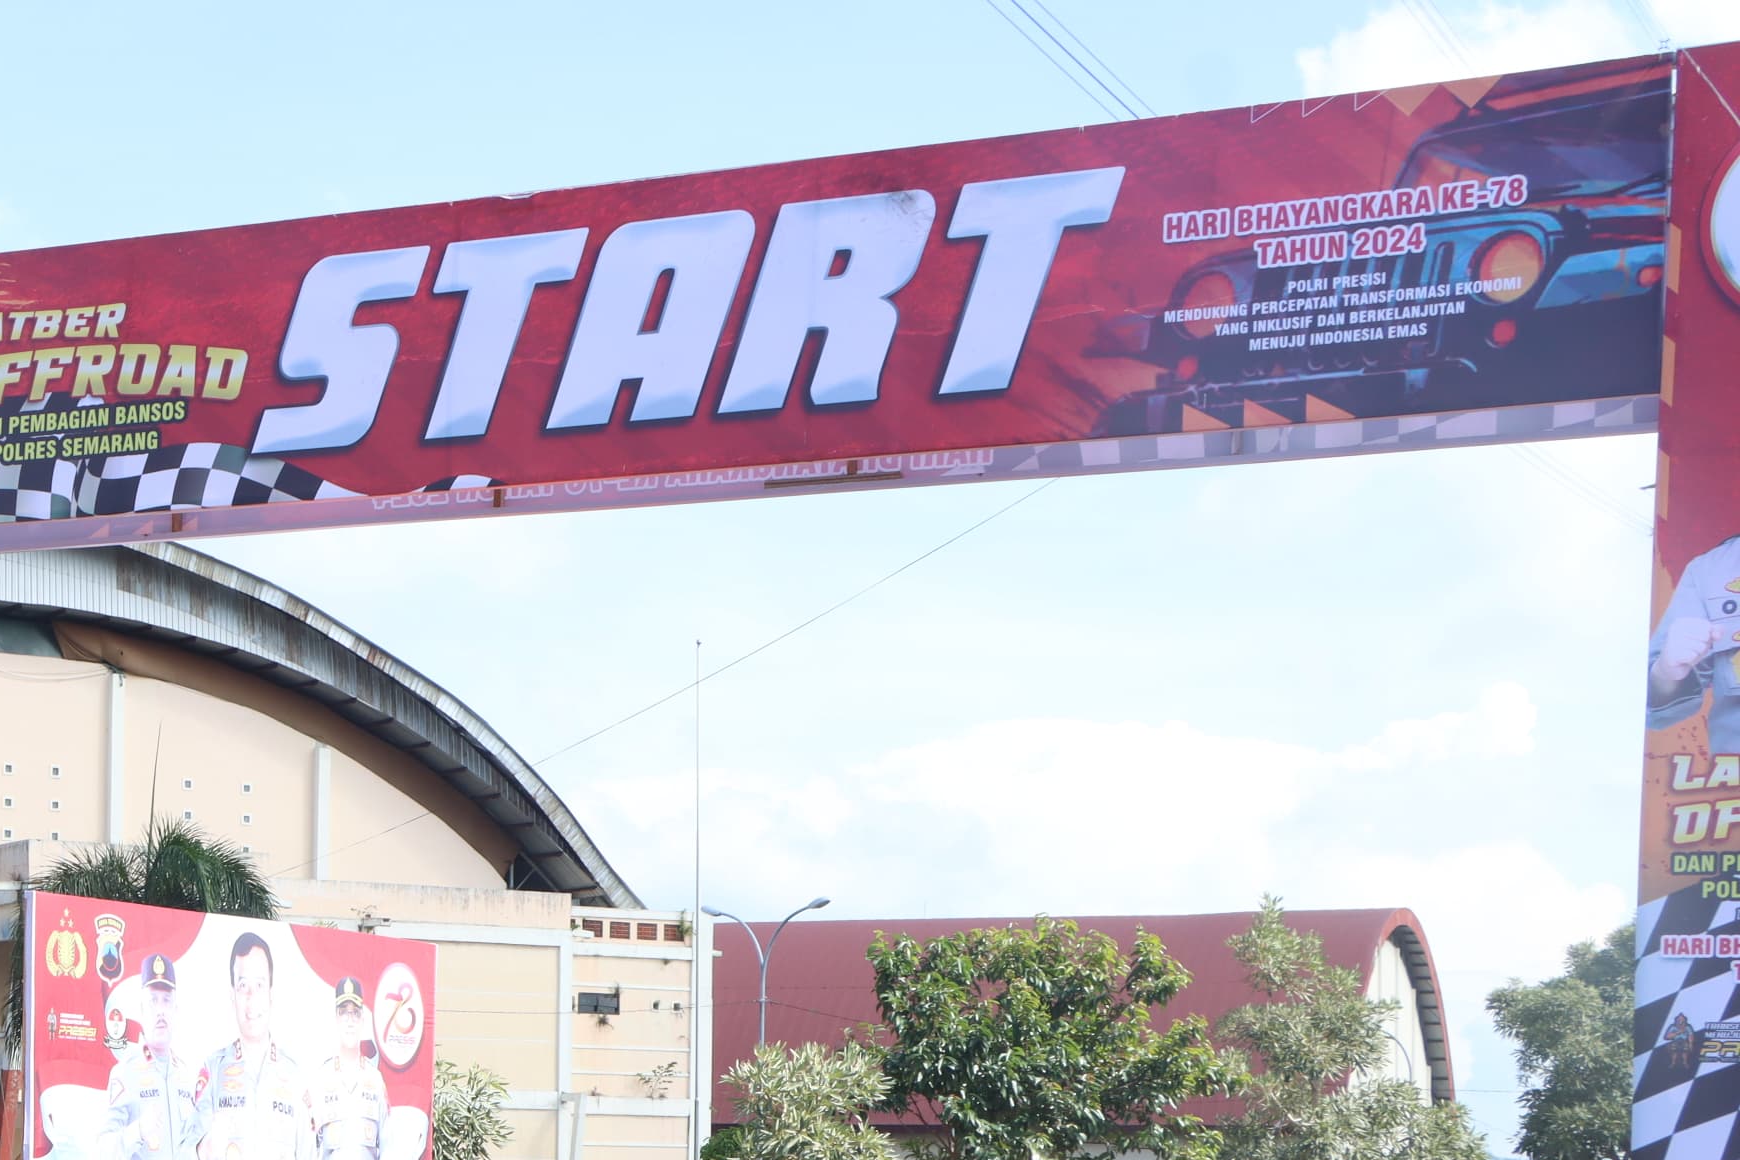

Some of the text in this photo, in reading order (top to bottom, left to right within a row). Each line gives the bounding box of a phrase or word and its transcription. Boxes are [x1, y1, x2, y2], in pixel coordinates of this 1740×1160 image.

[1165, 177, 1526, 241] HARI BHAYANGKARA KE-78
[1256, 226, 1424, 267] TAHUN 2024
[1164, 276, 1522, 323] MENDUKUNG PERCEPATAN TRANSFORMASI EKONOMI
[1288, 272, 1386, 294] POLRI PRESISI
[250, 165, 1126, 455] START
[1214, 301, 1465, 337] YANG INKLUSIF DAN BERKELANJUTAN
[1248, 322, 1428, 352] MENUJU INDONESIA EMAS
[9, 407, 109, 435] PEMBAGIAN
[115, 400, 186, 425] BANSOS
[62, 431, 159, 458] SEMARANG
[1673, 854, 1715, 874] DAN
[1663, 937, 1712, 956] HARI
